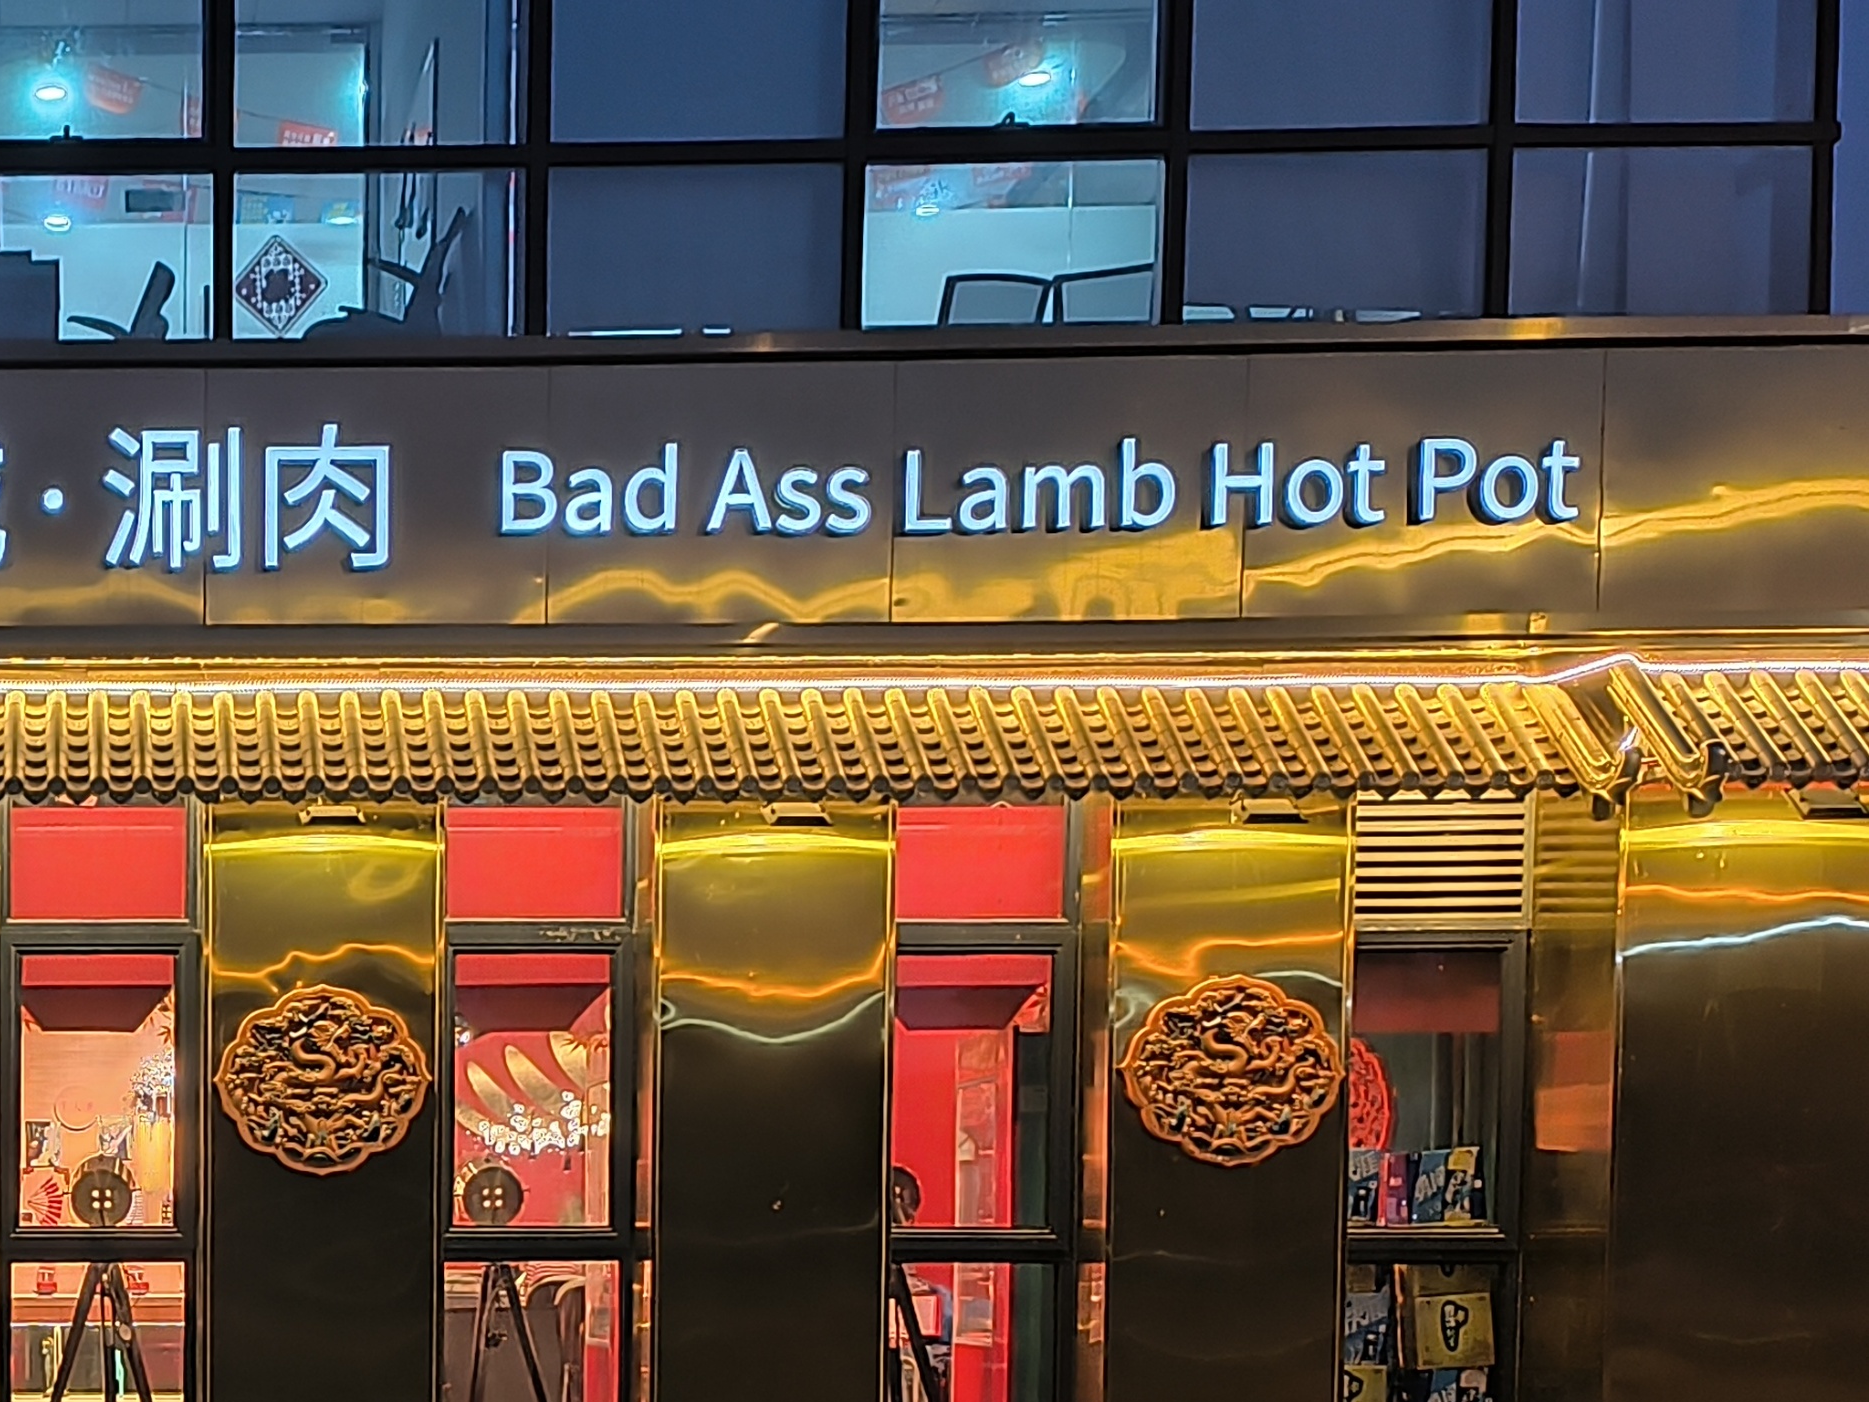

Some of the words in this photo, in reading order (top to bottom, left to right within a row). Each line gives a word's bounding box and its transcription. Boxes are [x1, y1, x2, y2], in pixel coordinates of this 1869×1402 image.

[498, 442, 678, 535] Bad
[706, 447, 872, 535] Ass
[903, 437, 1176, 533] Lamb
[1208, 441, 1386, 526] Hot
[1418, 437, 1580, 524] Pot
